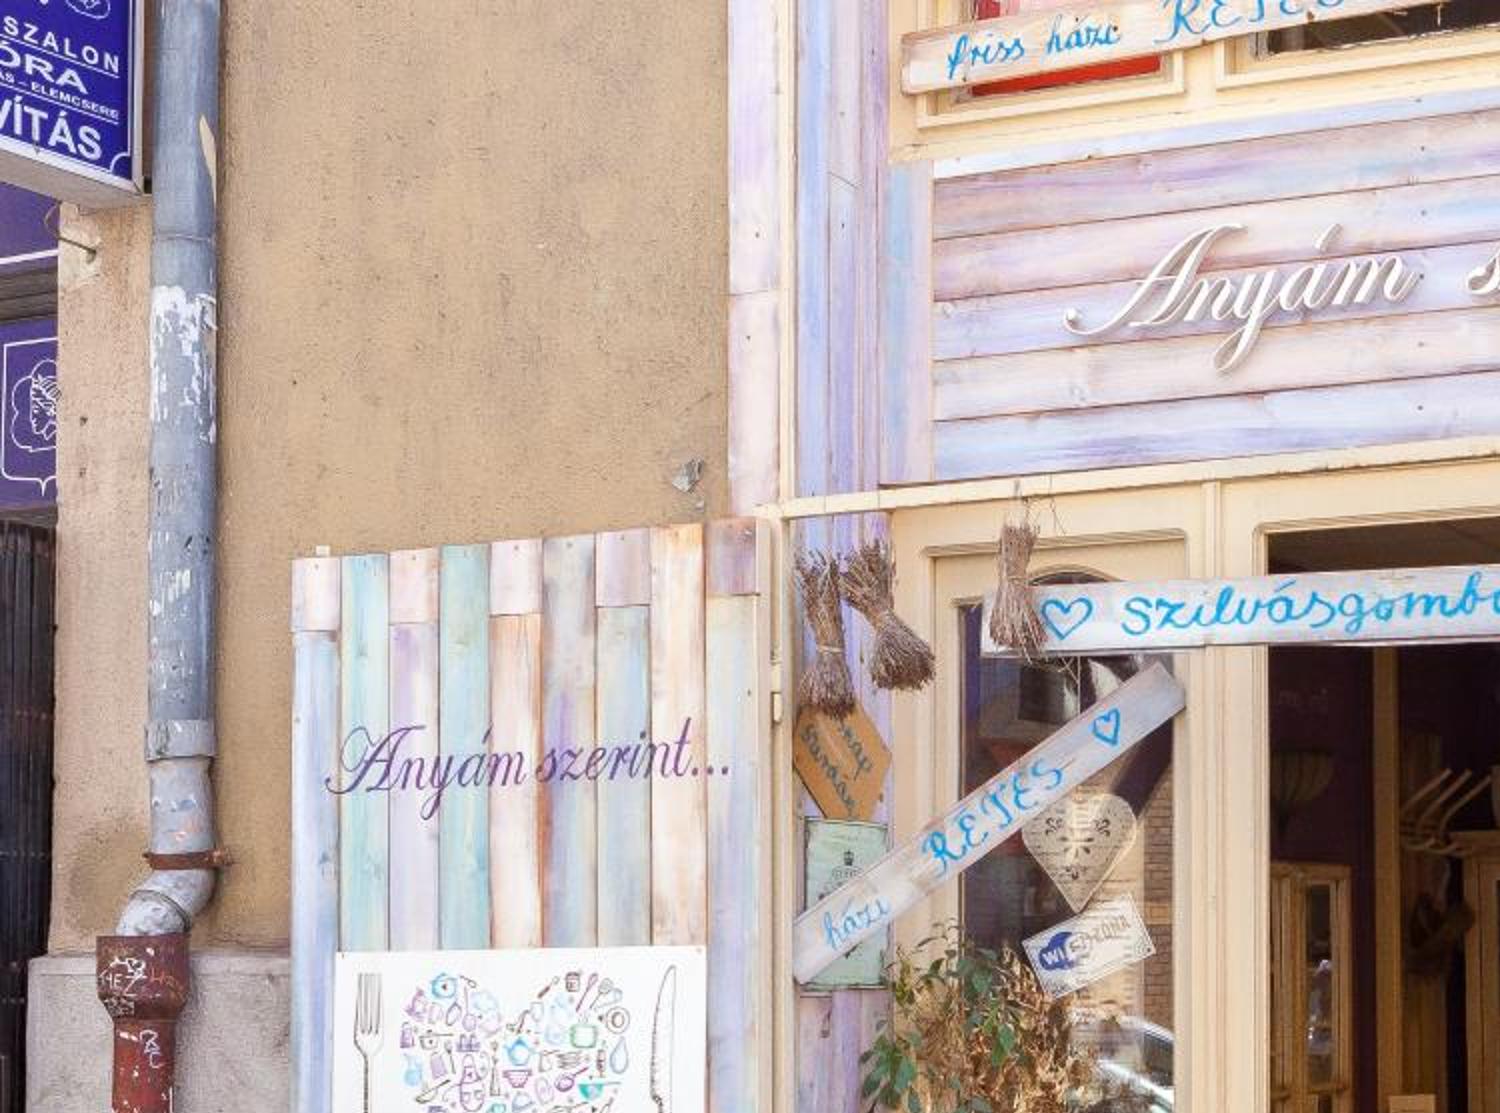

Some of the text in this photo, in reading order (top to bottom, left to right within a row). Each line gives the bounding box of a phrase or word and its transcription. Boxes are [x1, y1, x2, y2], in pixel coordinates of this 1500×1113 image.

[3, 16, 119, 73] SZALON
[1062, 222, 1418, 375] Anyám
[324, 720, 528, 821] Anyám
